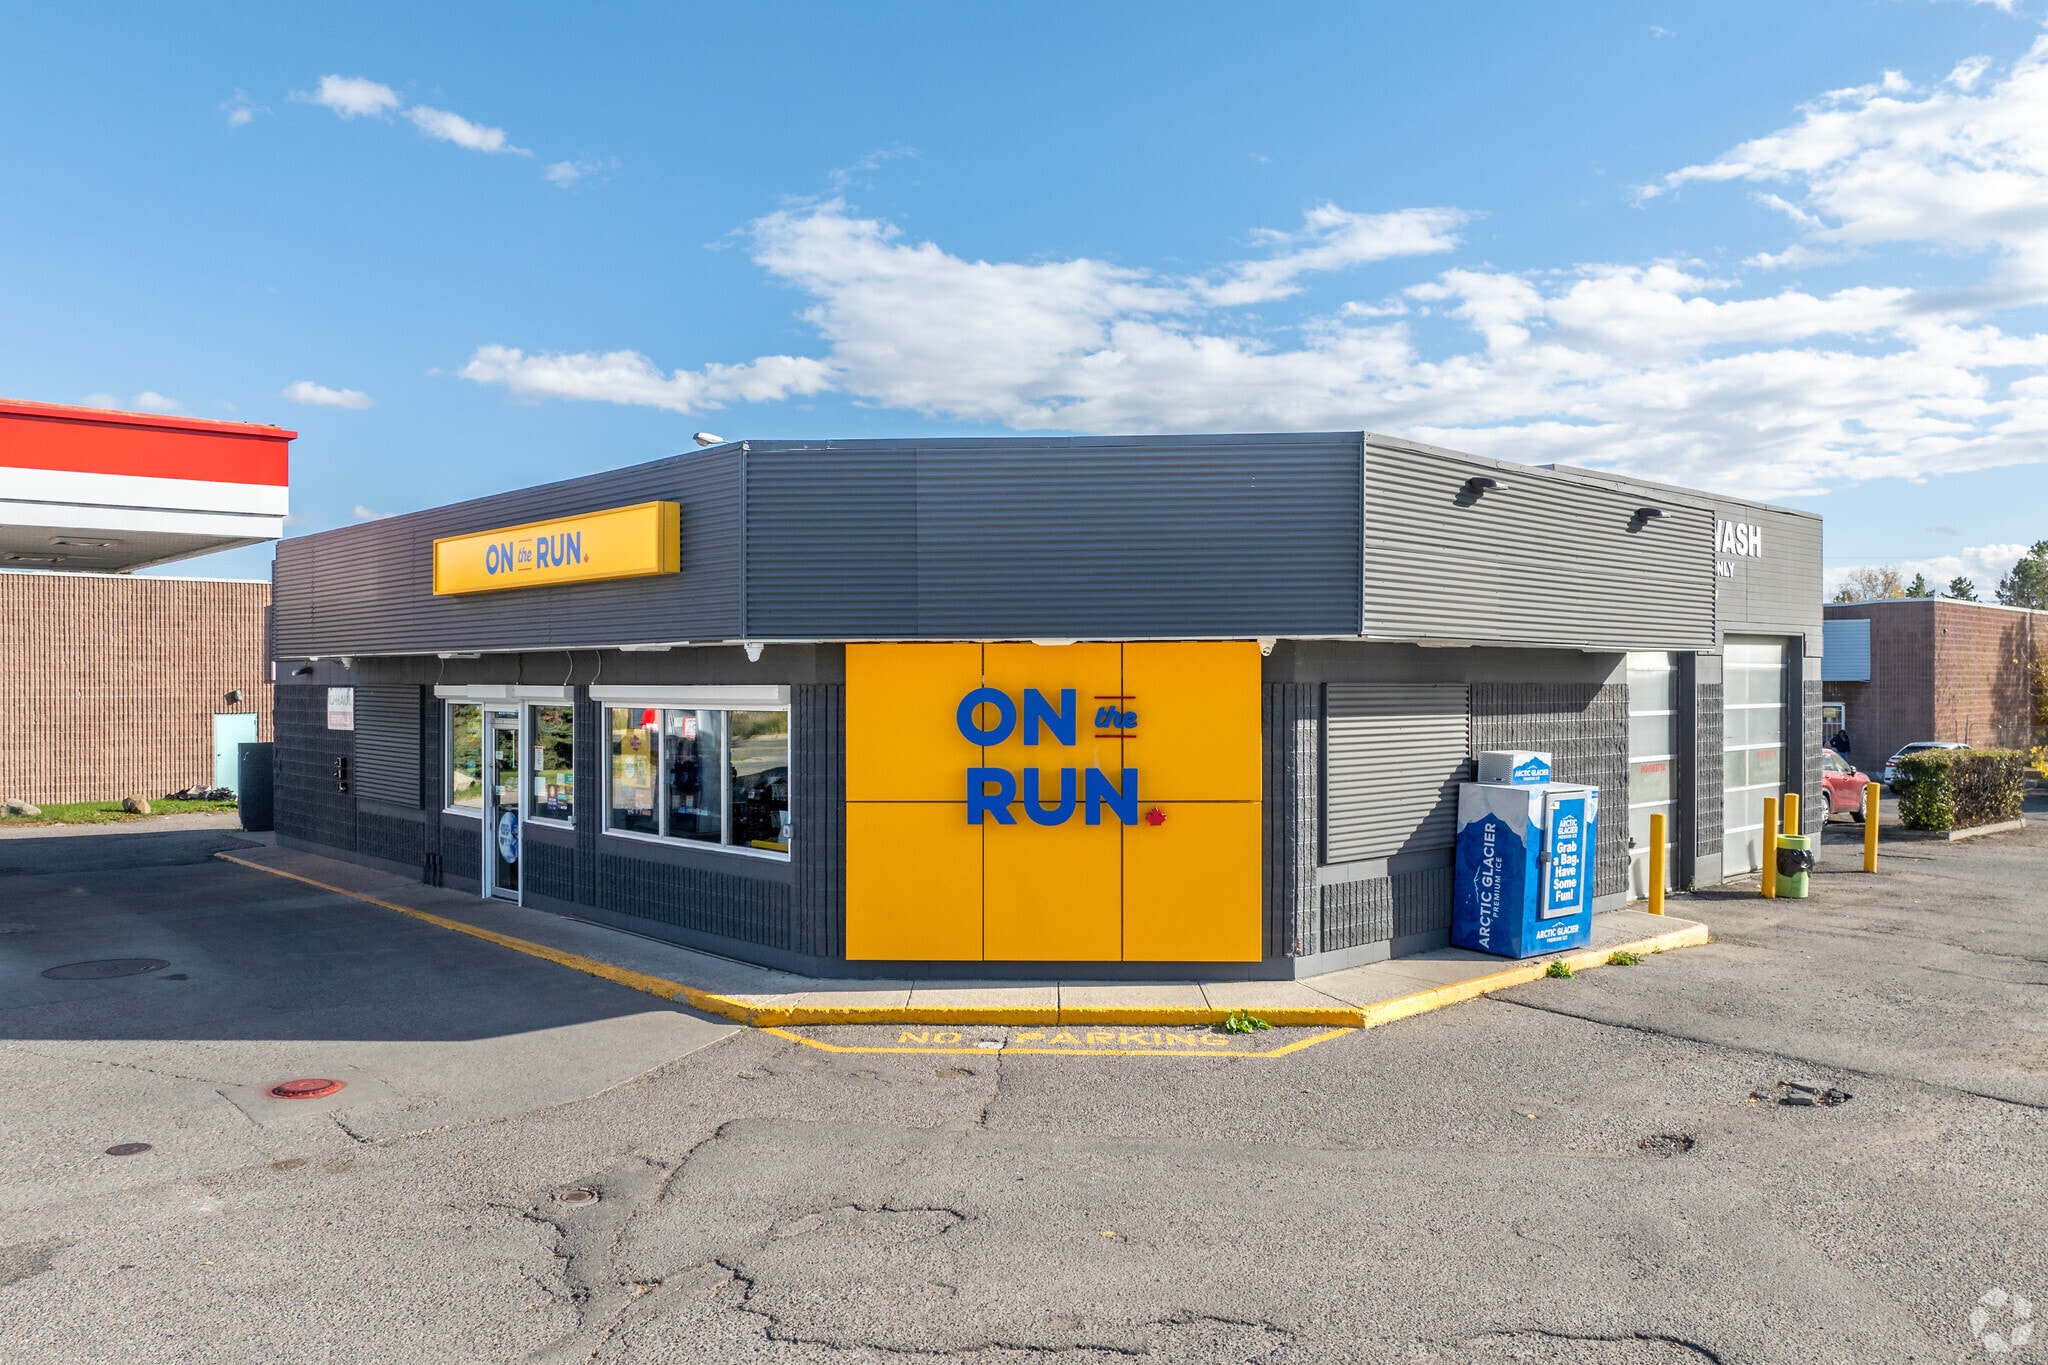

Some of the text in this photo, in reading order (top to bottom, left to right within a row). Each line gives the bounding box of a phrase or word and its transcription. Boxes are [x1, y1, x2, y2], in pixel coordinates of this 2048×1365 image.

[486, 531, 581, 575] ON the RUN
[1715, 561, 1735, 578] NLY
[956, 687, 1138, 747] ON the
[1514, 768, 1549, 777] ARCTIC GLACIER
[967, 768, 1139, 827] RUN
[1560, 819, 1578, 827] ARCTIC
[1558, 826, 1579, 835] GLACIER
[1556, 841, 1577, 853] Grab
[1553, 854, 1580, 866] a Bag.
[1555, 866, 1576, 878] Have
[1478, 822, 1496, 949] ARCTIC GLACIER
[1553, 878, 1577, 890] Some
[1492, 875, 1501, 918] PREMIUM
[1555, 888, 1574, 902] Fun!
[1536, 924, 1579, 940] ARCTIC GLACIER
[898, 1031, 1229, 1046] NO PARKING
